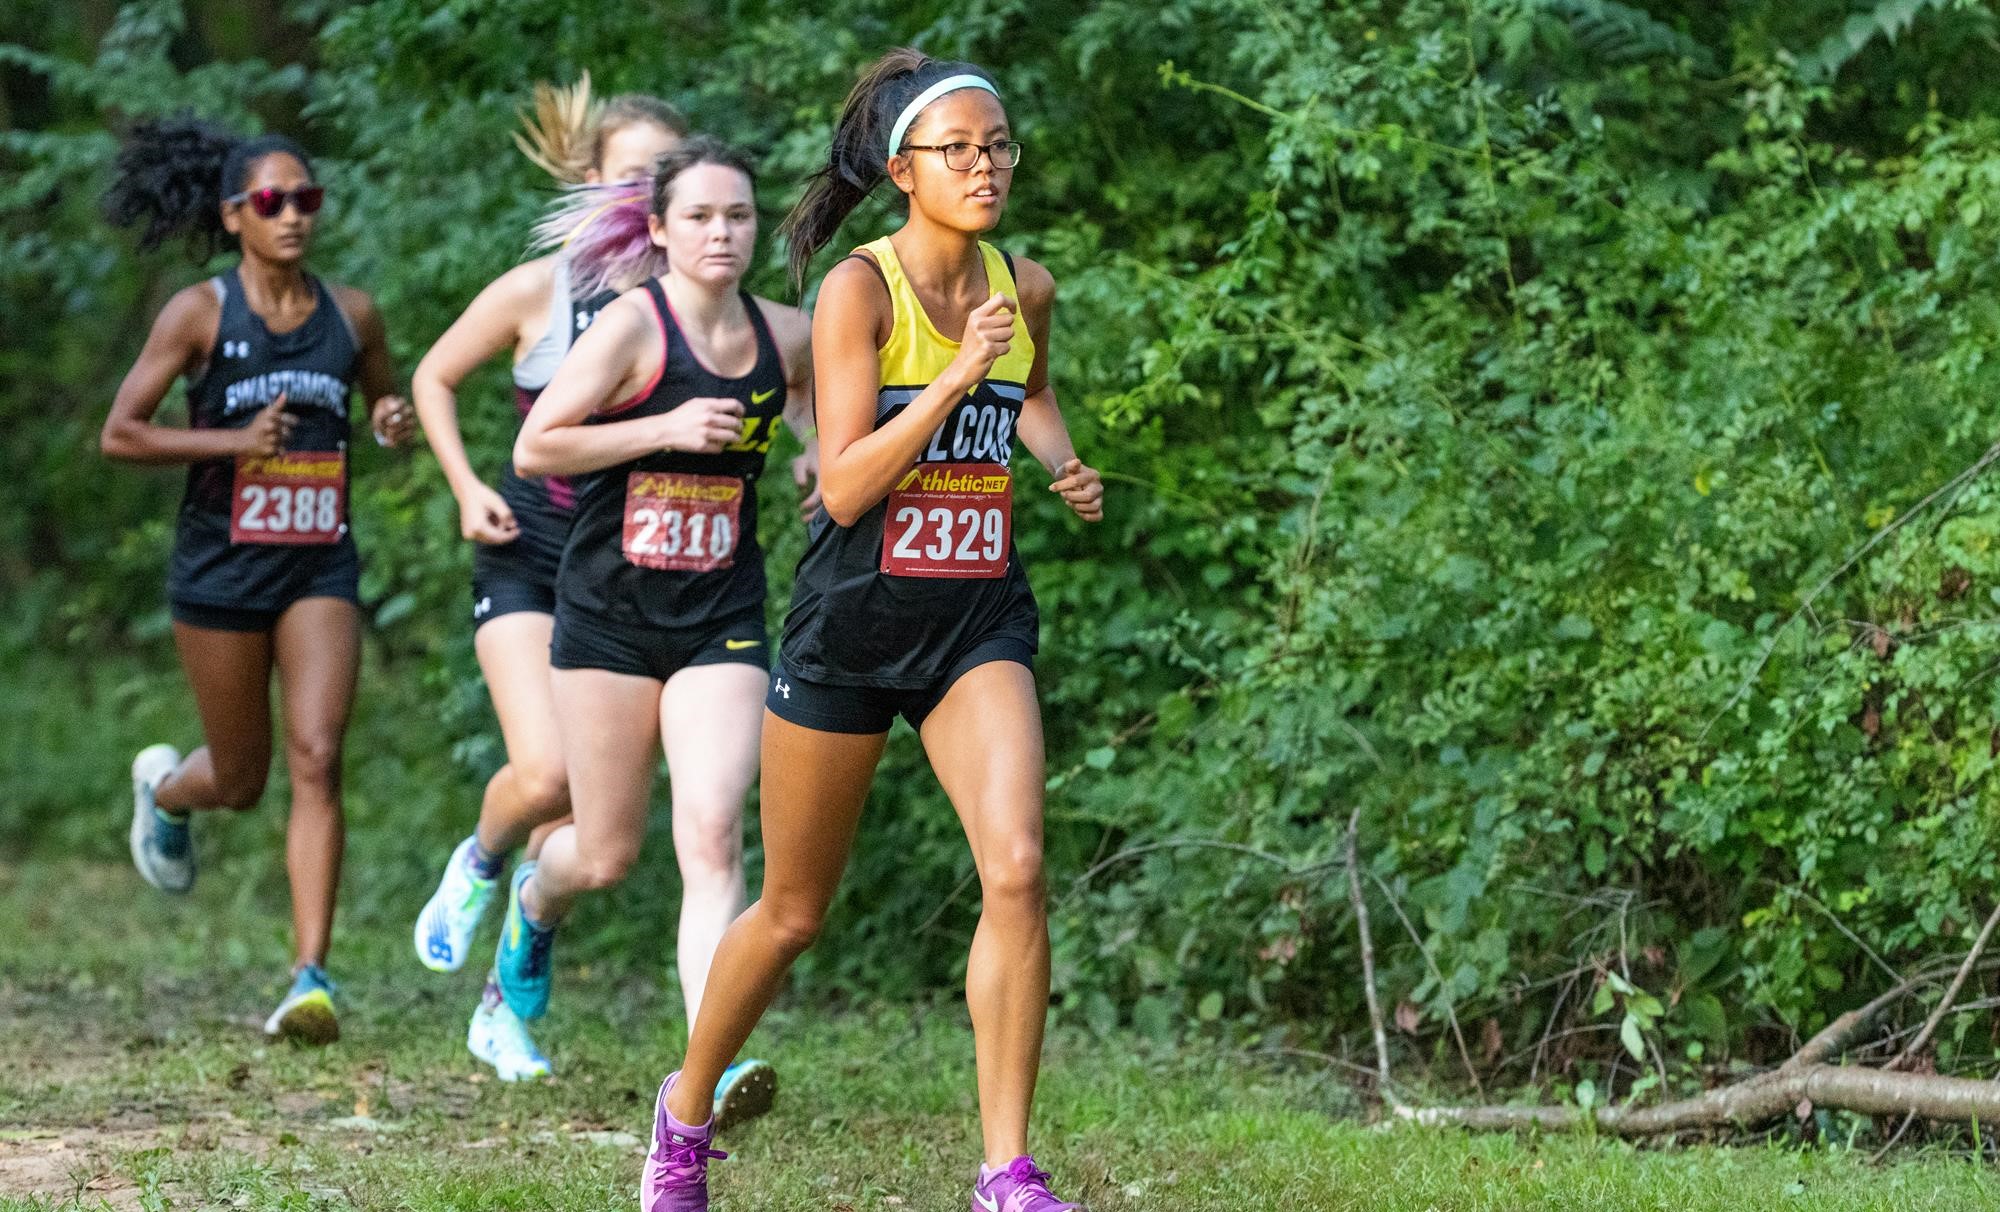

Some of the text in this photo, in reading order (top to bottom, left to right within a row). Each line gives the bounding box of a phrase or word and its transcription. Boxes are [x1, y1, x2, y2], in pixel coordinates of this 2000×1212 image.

[915, 404, 1016, 467] LCON
[239, 484, 337, 532] 2388
[631, 508, 731, 560] 2310
[892, 506, 1003, 561] 2329
